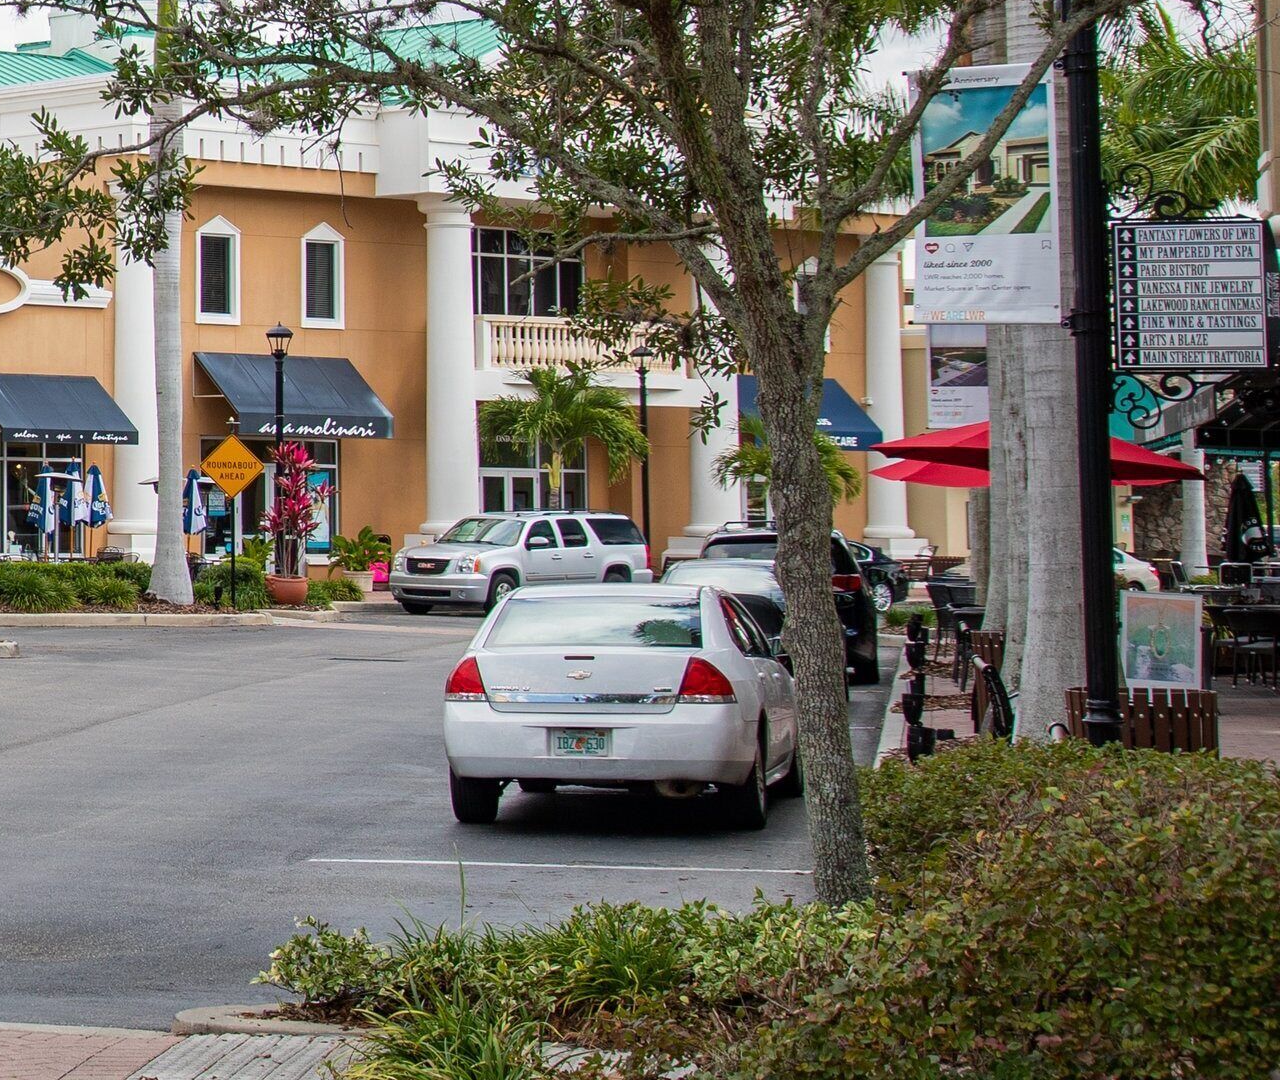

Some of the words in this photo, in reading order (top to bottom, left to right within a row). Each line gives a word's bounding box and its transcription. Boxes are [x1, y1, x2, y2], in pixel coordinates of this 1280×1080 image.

[953, 76, 1000, 84] Anniversary
[1138, 229, 1176, 242] FANTASY
[1179, 228, 1220, 241] FLOWERS
[1222, 228, 1234, 240] OF
[1236, 227, 1255, 240] LWR
[1139, 247, 1154, 259] MY
[1157, 247, 1210, 259] PAMPERED
[1213, 246, 1233, 258] PET
[1235, 245, 1254, 258] SPA
[923, 260, 944, 269] liked
[945, 260, 968, 268] since
[970, 259, 992, 267] 2000
[1140, 264, 1167, 277] PARIS
[1169, 263, 1209, 276] BISTROT
[1141, 281, 1182, 294] VANESSA
[1184, 281, 1206, 293] FINE
[1209, 280, 1254, 293] JEWELRY
[1141, 299, 1188, 311] LAKEWOOD
[1191, 298, 1220, 311] RANCH
[1221, 298, 1261, 310] CINEMAS
[922, 310, 986, 321] #WEARELWR
[1141, 316, 1165, 328] FINE
[1168, 316, 1194, 328] WINE
[1197, 316, 1204, 328] &
[1207, 315, 1257, 328] TASTINGS
[1142, 334, 1167, 346] ARTS
[1169, 334, 1175, 345] A
[1177, 333, 1208, 346] BLAZE
[1143, 351, 1167, 363] MAIN
[1169, 351, 1206, 363] STREET
[1207, 350, 1261, 363] TRATTORIA
[295, 417, 376, 437] molinari
[13, 429, 38, 438] salon
[56, 433, 72, 441] spa
[92, 432, 128, 443] boutique
[206, 461, 258, 470] ROUNDABOUT
[219, 472, 245, 481] AHEAD
